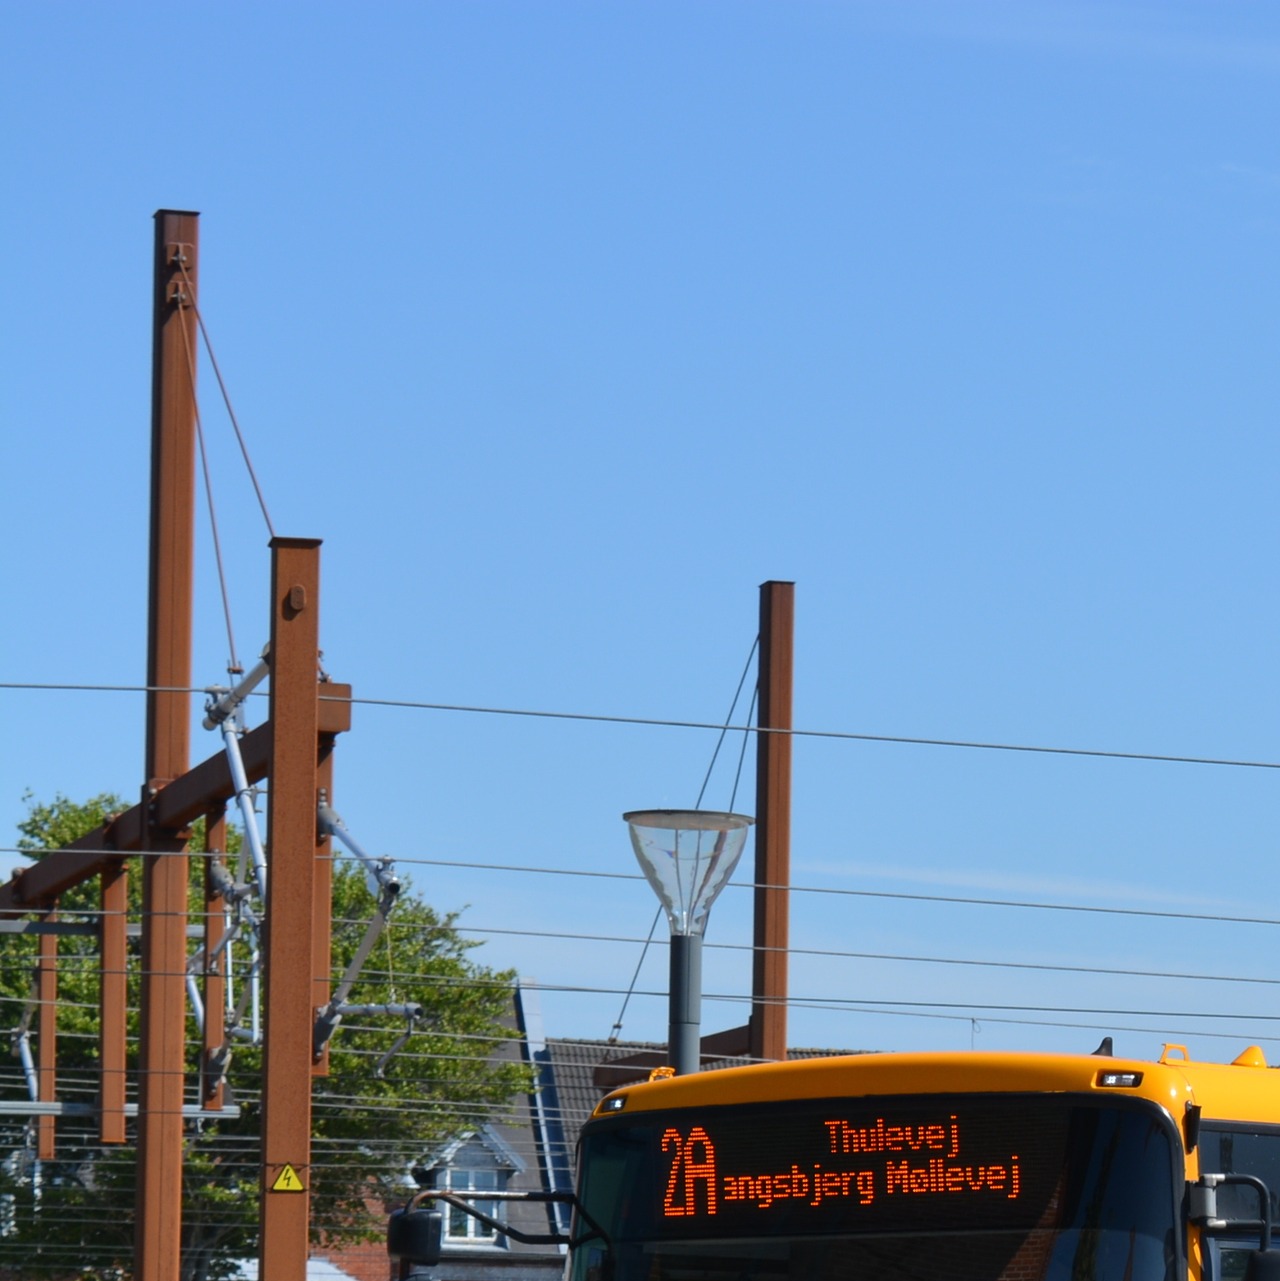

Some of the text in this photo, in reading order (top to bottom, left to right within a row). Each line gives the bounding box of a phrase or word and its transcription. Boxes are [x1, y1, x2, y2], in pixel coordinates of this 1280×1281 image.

[824, 1115, 959, 1158] Thulevej
[661, 1127, 716, 1216] 2A
[886, 1155, 1019, 1199] Møllevej
